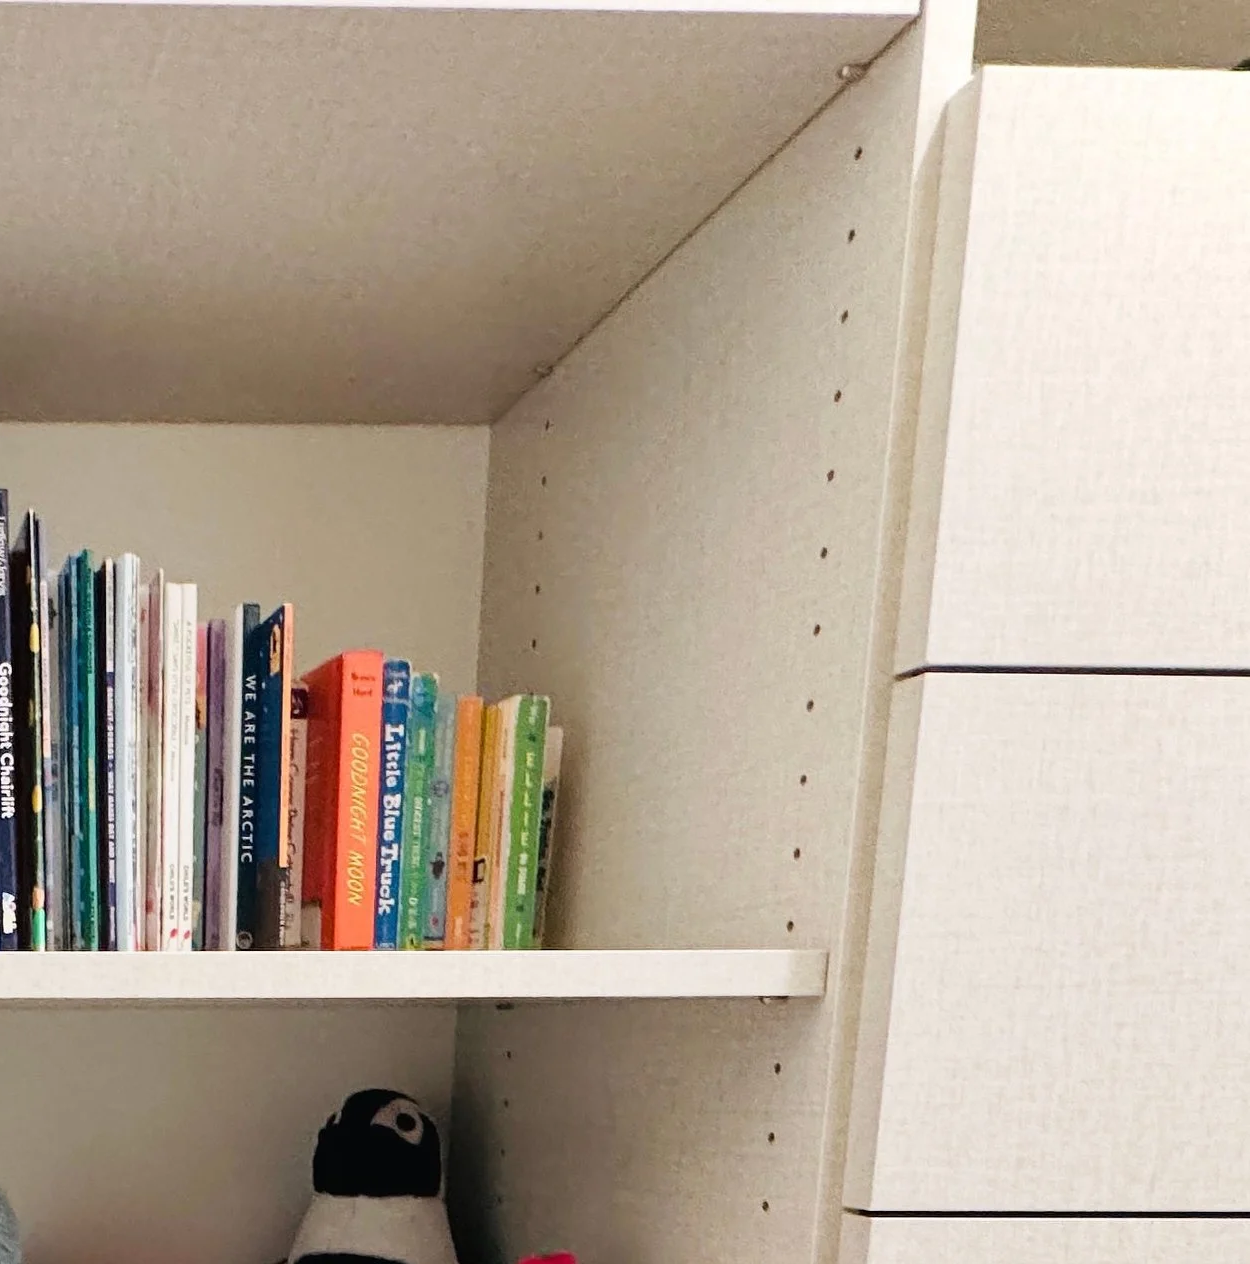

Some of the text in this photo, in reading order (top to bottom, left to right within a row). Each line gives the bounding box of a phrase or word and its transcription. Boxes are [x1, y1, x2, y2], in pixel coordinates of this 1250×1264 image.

[0, 752, 16, 819] Chairlift
[240, 674, 257, 863] WE ARE THE ARCTIC
[349, 733, 370, 906] GOODNIGHT MOON
[379, 723, 404, 916] Little Blue Truck
